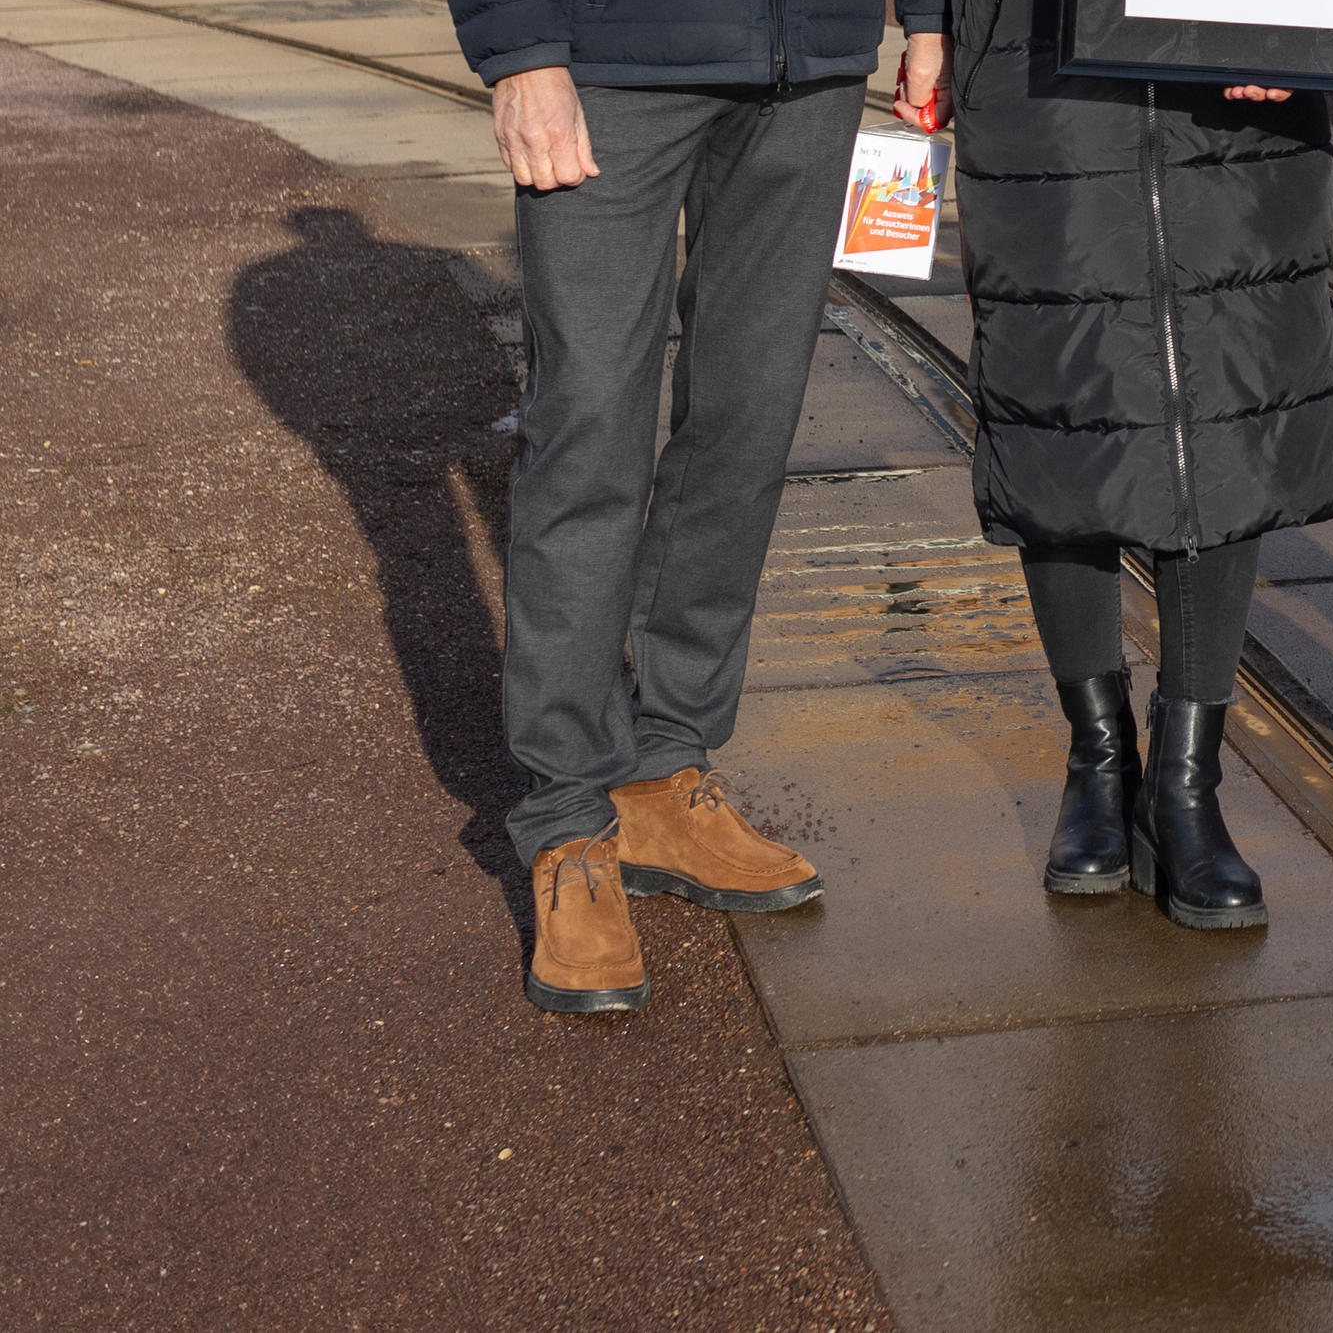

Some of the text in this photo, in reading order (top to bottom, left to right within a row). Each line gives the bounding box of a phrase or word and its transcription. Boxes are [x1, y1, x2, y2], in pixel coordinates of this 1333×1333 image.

[862, 216, 875, 225] für
[882, 209, 914, 221] Ausweis
[869, 228, 921, 241] und Besucher
